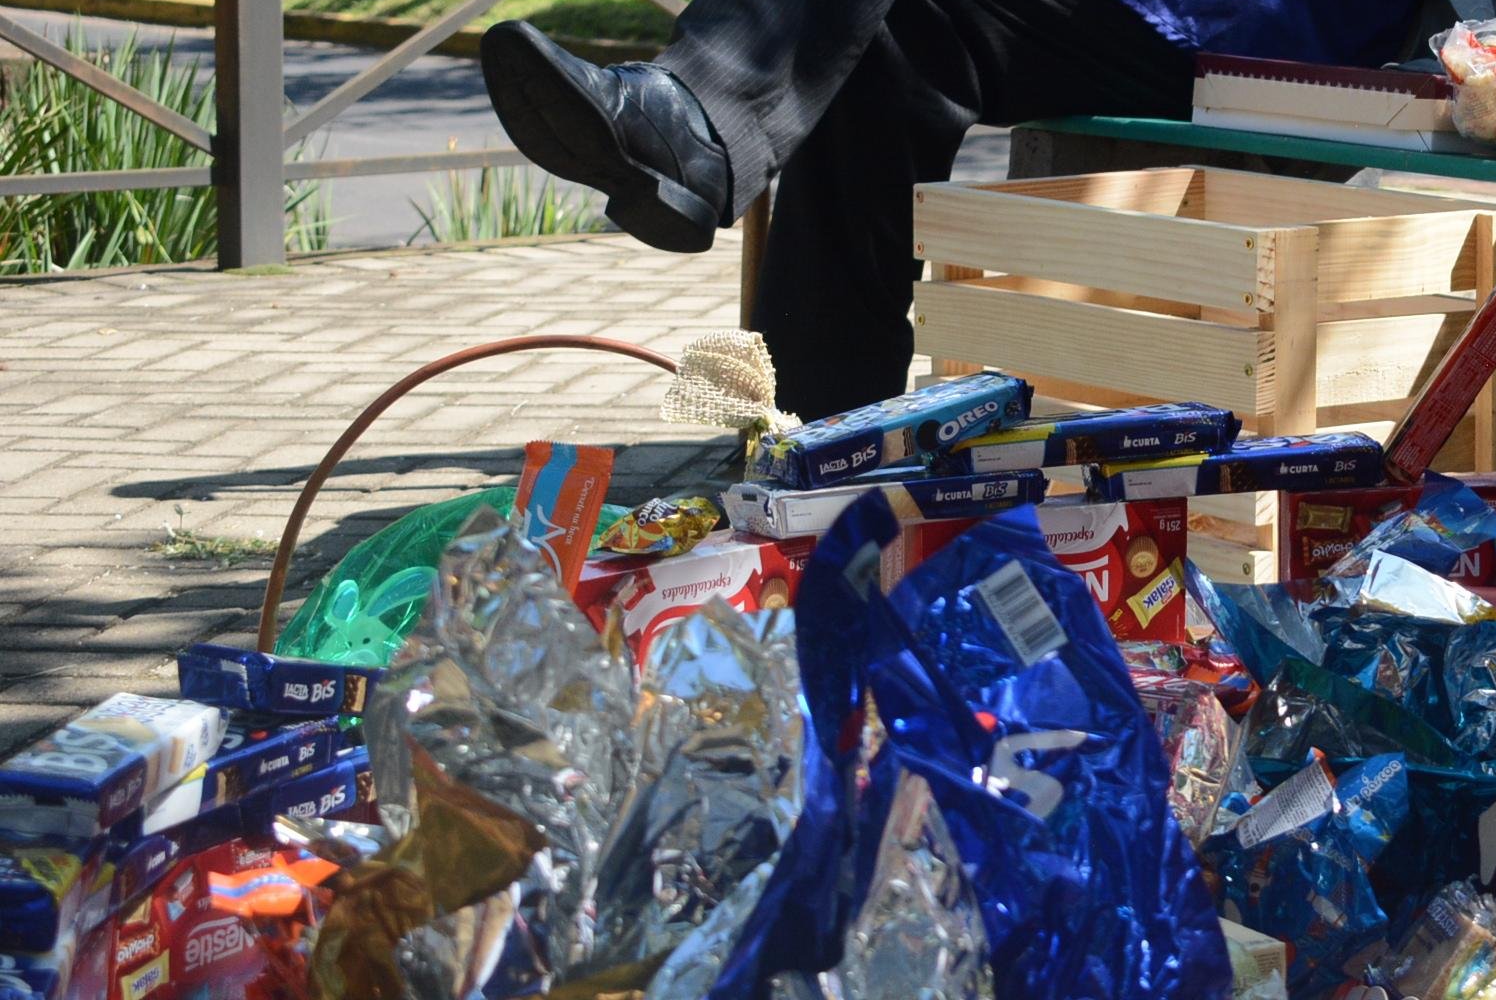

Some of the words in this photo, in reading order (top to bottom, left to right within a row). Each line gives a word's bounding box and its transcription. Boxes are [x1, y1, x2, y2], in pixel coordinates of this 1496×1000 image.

[938, 400, 999, 441] OREO
[1132, 438, 1160, 447] CURTA
[819, 458, 849, 476] LACTA
[1289, 464, 1319, 474] CURTA
[944, 490, 973, 500] CURTA
[1167, 519, 1182, 531] 251
[662, 572, 732, 602] especialidades
[1143, 576, 1175, 609] Galak
[283, 682, 309, 700] LACTA
[288, 801, 317, 818] LACTA
